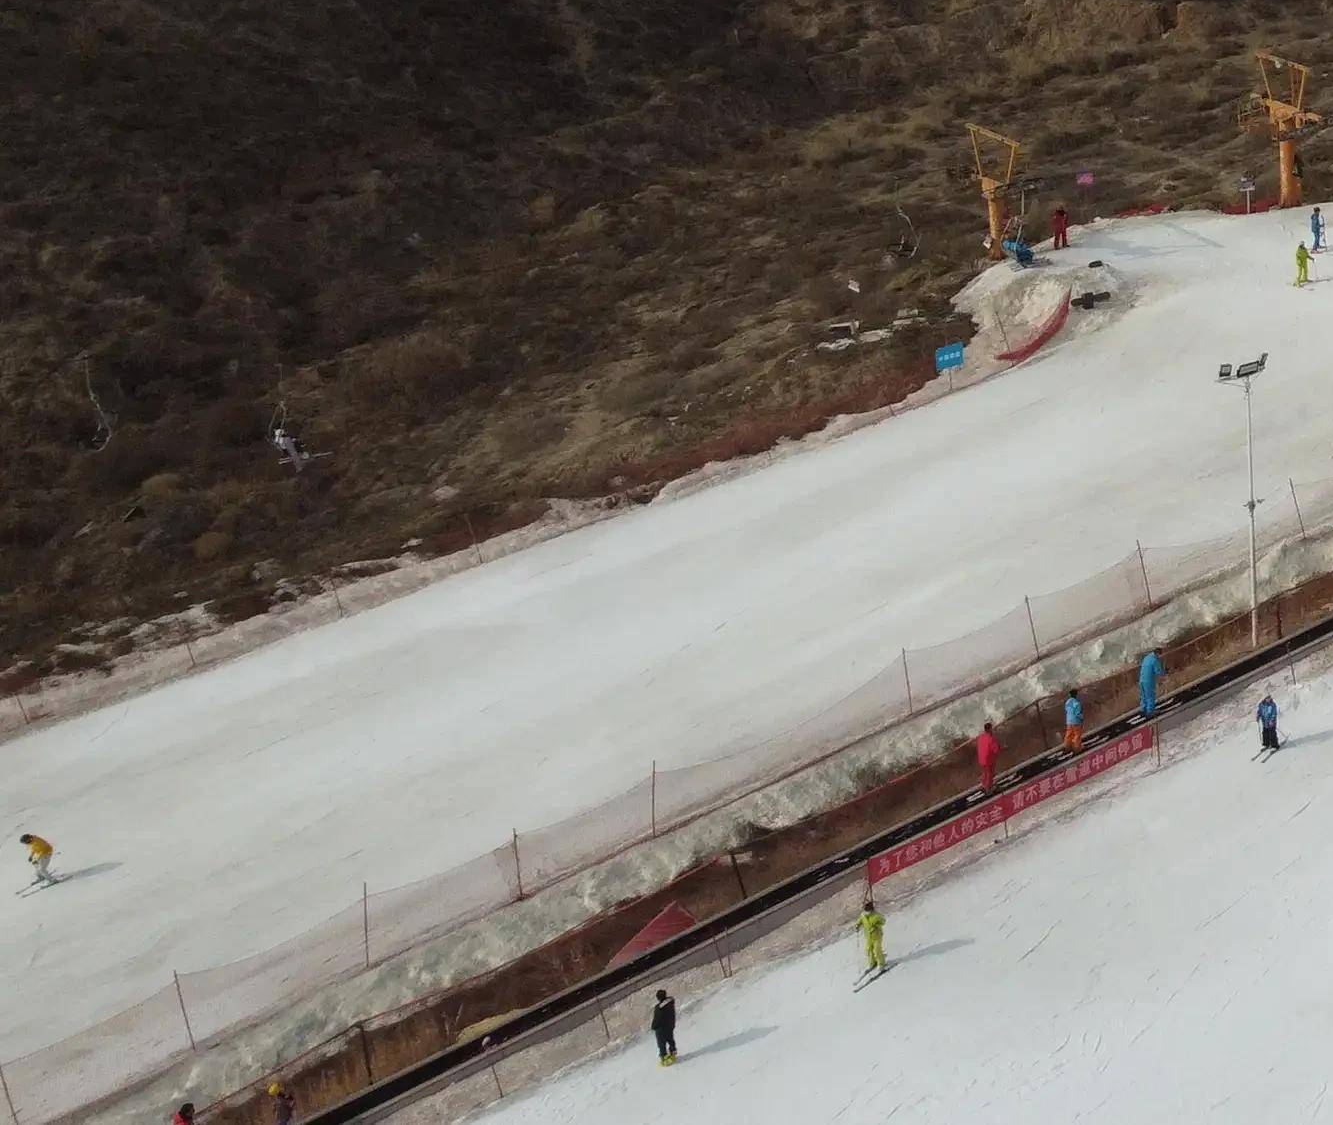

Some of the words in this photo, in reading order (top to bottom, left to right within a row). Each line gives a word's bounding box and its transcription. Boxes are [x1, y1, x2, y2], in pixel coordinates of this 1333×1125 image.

[879, 805, 1003, 874] 为了您和他人的安全
